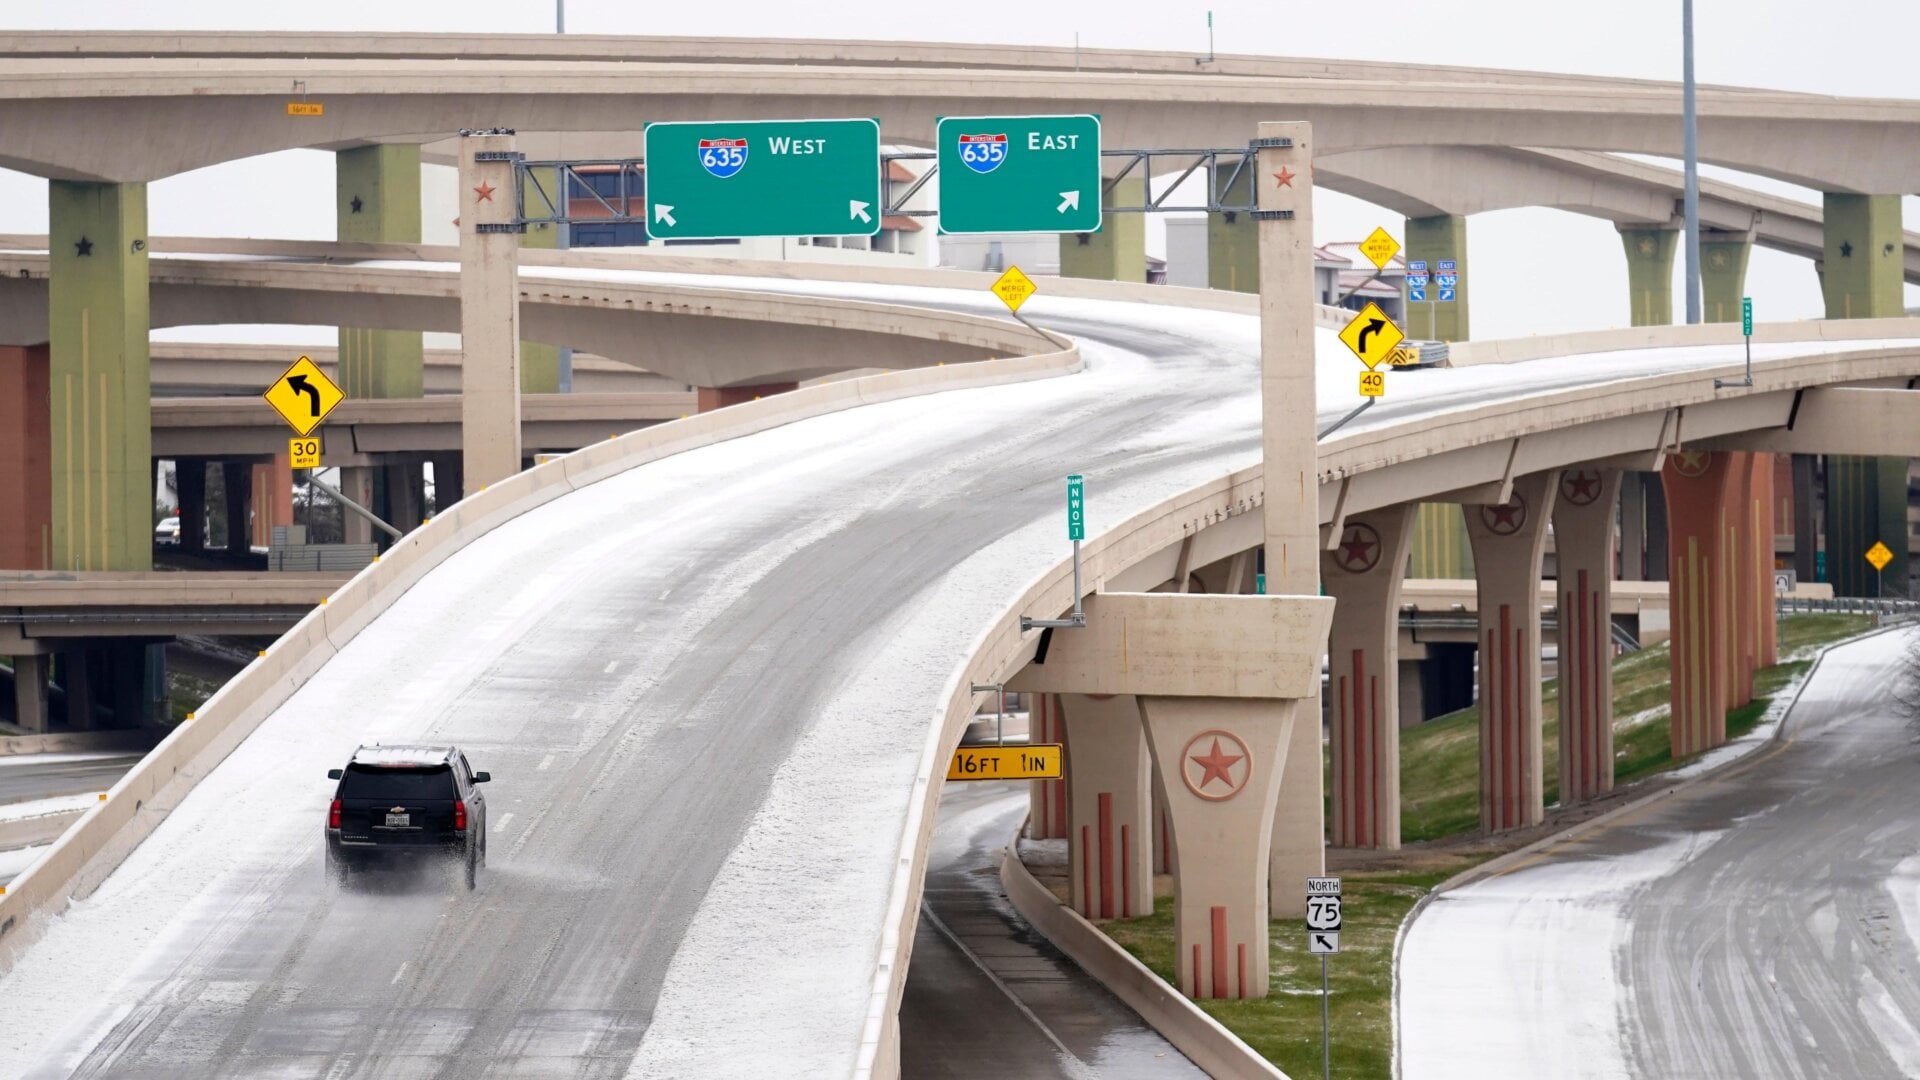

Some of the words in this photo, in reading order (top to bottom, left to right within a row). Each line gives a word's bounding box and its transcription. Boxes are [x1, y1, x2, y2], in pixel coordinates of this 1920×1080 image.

[768, 136, 826, 155] WEST
[1028, 132, 1079, 151] EAST
[703, 148, 743, 167] 635
[963, 143, 1003, 162] 635
[1371, 252, 1389, 260] LEFT
[1408, 276, 1426, 286] 635
[1438, 276, 1456, 285] 635
[1005, 293, 1023, 301] LEFT
[1362, 374, 1382, 386] 40
[293, 441, 317, 457] 30
[1308, 880, 1339, 891] NORTH
[1310, 903, 1338, 922] 75
